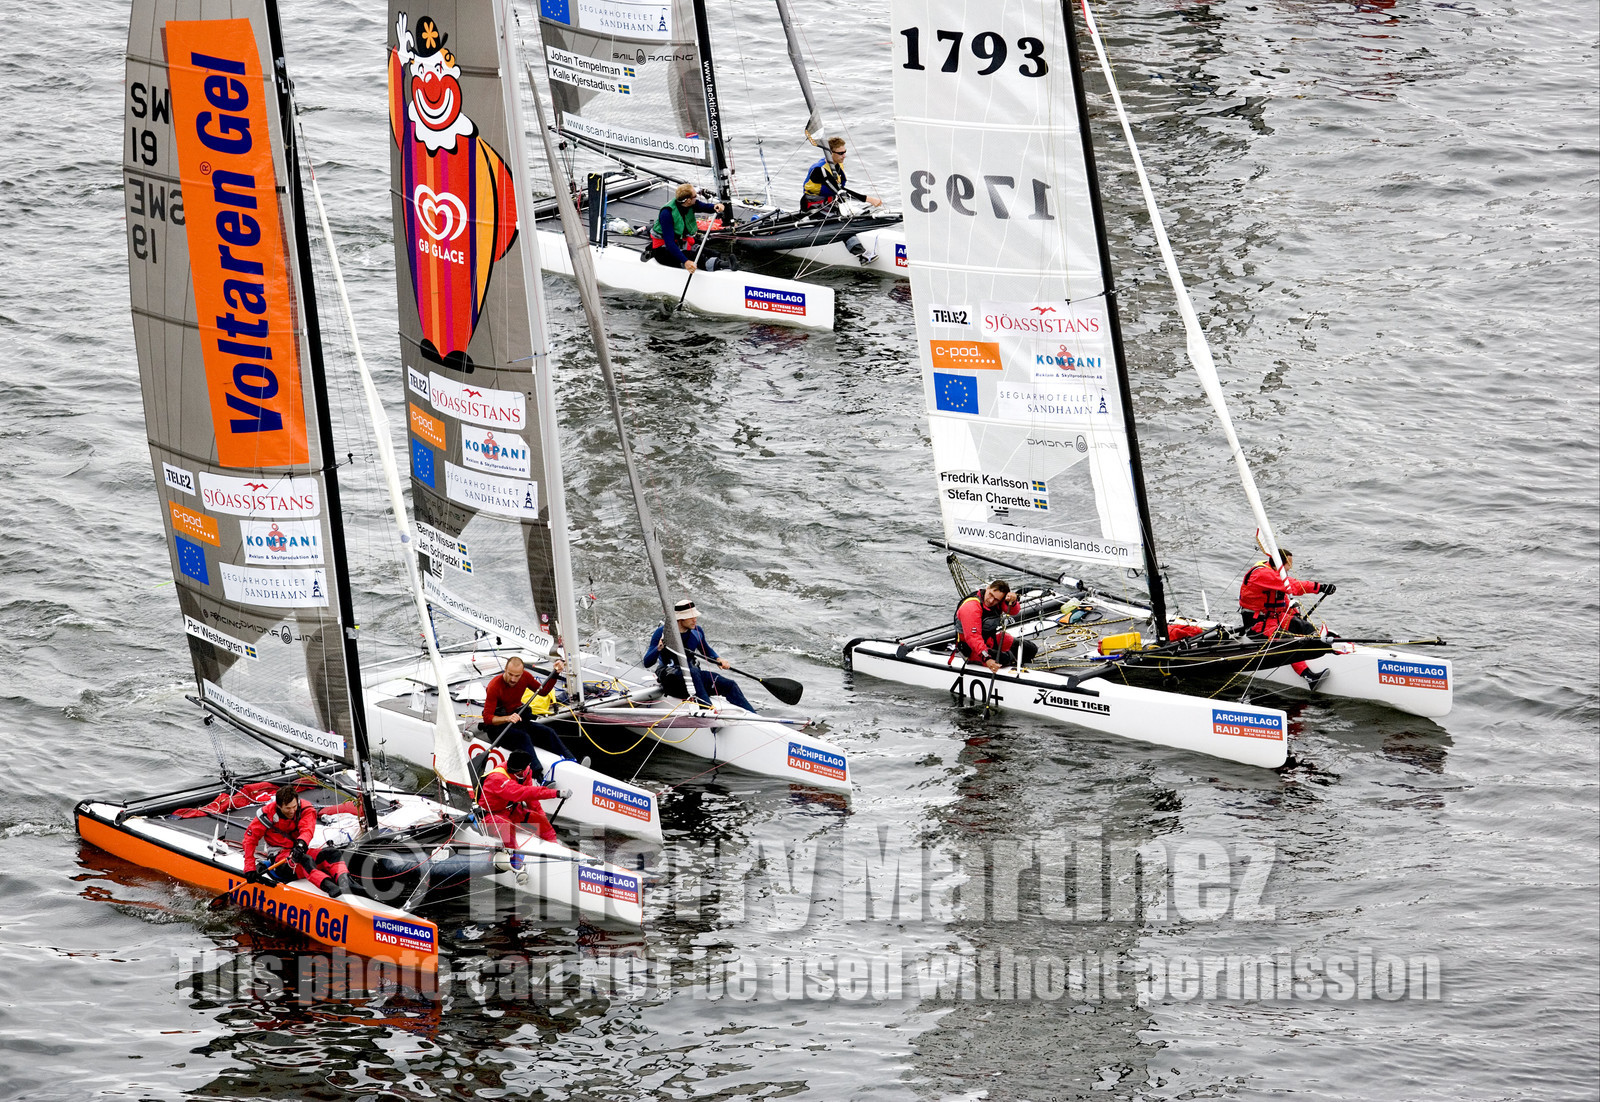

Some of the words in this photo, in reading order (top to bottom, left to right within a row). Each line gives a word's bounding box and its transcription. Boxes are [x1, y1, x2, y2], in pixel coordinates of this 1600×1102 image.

[580, 3, 653, 20] SEGLARHOTELLET
[600, 18, 653, 31] SANDHAMN
[612, 53, 634, 61] SAIL
[648, 54, 694, 62] RACING
[900, 26, 1049, 78] 1793
[551, 50, 572, 65] Johan
[574, 56, 620, 76] Tempelman
[552, 68, 570, 81] Kalle
[571, 74, 616, 92] Kjerstadius
[191, 51, 253, 155] Gel
[703, 61, 719, 139] www.tacktick.com
[566, 119, 699, 154] www.scandinavianislands.com
[419, 238, 429, 252] GB
[431, 244, 464, 265] GLACE
[747, 290, 803, 303] ARCHIPELAGO
[747, 300, 769, 310] RAID
[985, 314, 1099, 333] SJÖASSISTANS
[1036, 354, 1101, 368] KOMPANI
[432, 388, 520, 422] SJÖASSISTANS
[1000, 391, 1093, 402] SEGLARHOTELLET
[1027, 404, 1093, 414] SANDHAMN
[465, 439, 526, 459] KOMPANI
[940, 472, 979, 485] Fredrik
[982, 473, 1029, 490] Karlsson
[203, 489, 314, 511] SJÖASSISTANS
[464, 489, 519, 509] SANDHAMN
[947, 488, 982, 502] Stefan
[985, 492, 1030, 508] Charette
[246, 535, 317, 547] KOMPANI
[436, 532, 455, 550] Nissar
[957, 525, 1129, 556] www.scandinavianislands.com
[418, 539, 429, 553] Jan
[430, 544, 460, 568] Schiratzki
[223, 572, 305, 586] SEGLARHOTELLET
[245, 588, 307, 599] SANDHAMN
[187, 620, 200, 634] Per
[200, 625, 243, 653] Westergren
[1381, 663, 1444, 676] ARCHIPELAGO
[1381, 675, 1405, 685] RAID
[1050, 695, 1079, 707] HOBIE
[1080, 700, 1110, 712] TIGER
[207, 686, 338, 750] www.scandinavianislands.com
[1216, 713, 1279, 726] ARCHIPELAGO
[1216, 725, 1240, 735] RAID
[790, 758, 811, 770] RAID
[791, 747, 843, 766] ARCHIPELAGO
[594, 797, 615, 809] RAID
[596, 785, 649, 807] ARCHIPELAGO
[581, 870, 635, 888] ARCHIPELAGO
[581, 882, 601, 893] RAID
[316, 909, 348, 943] Gel
[376, 920, 431, 938] ARCHIPELAGO
[376, 932, 397, 944] RAID
